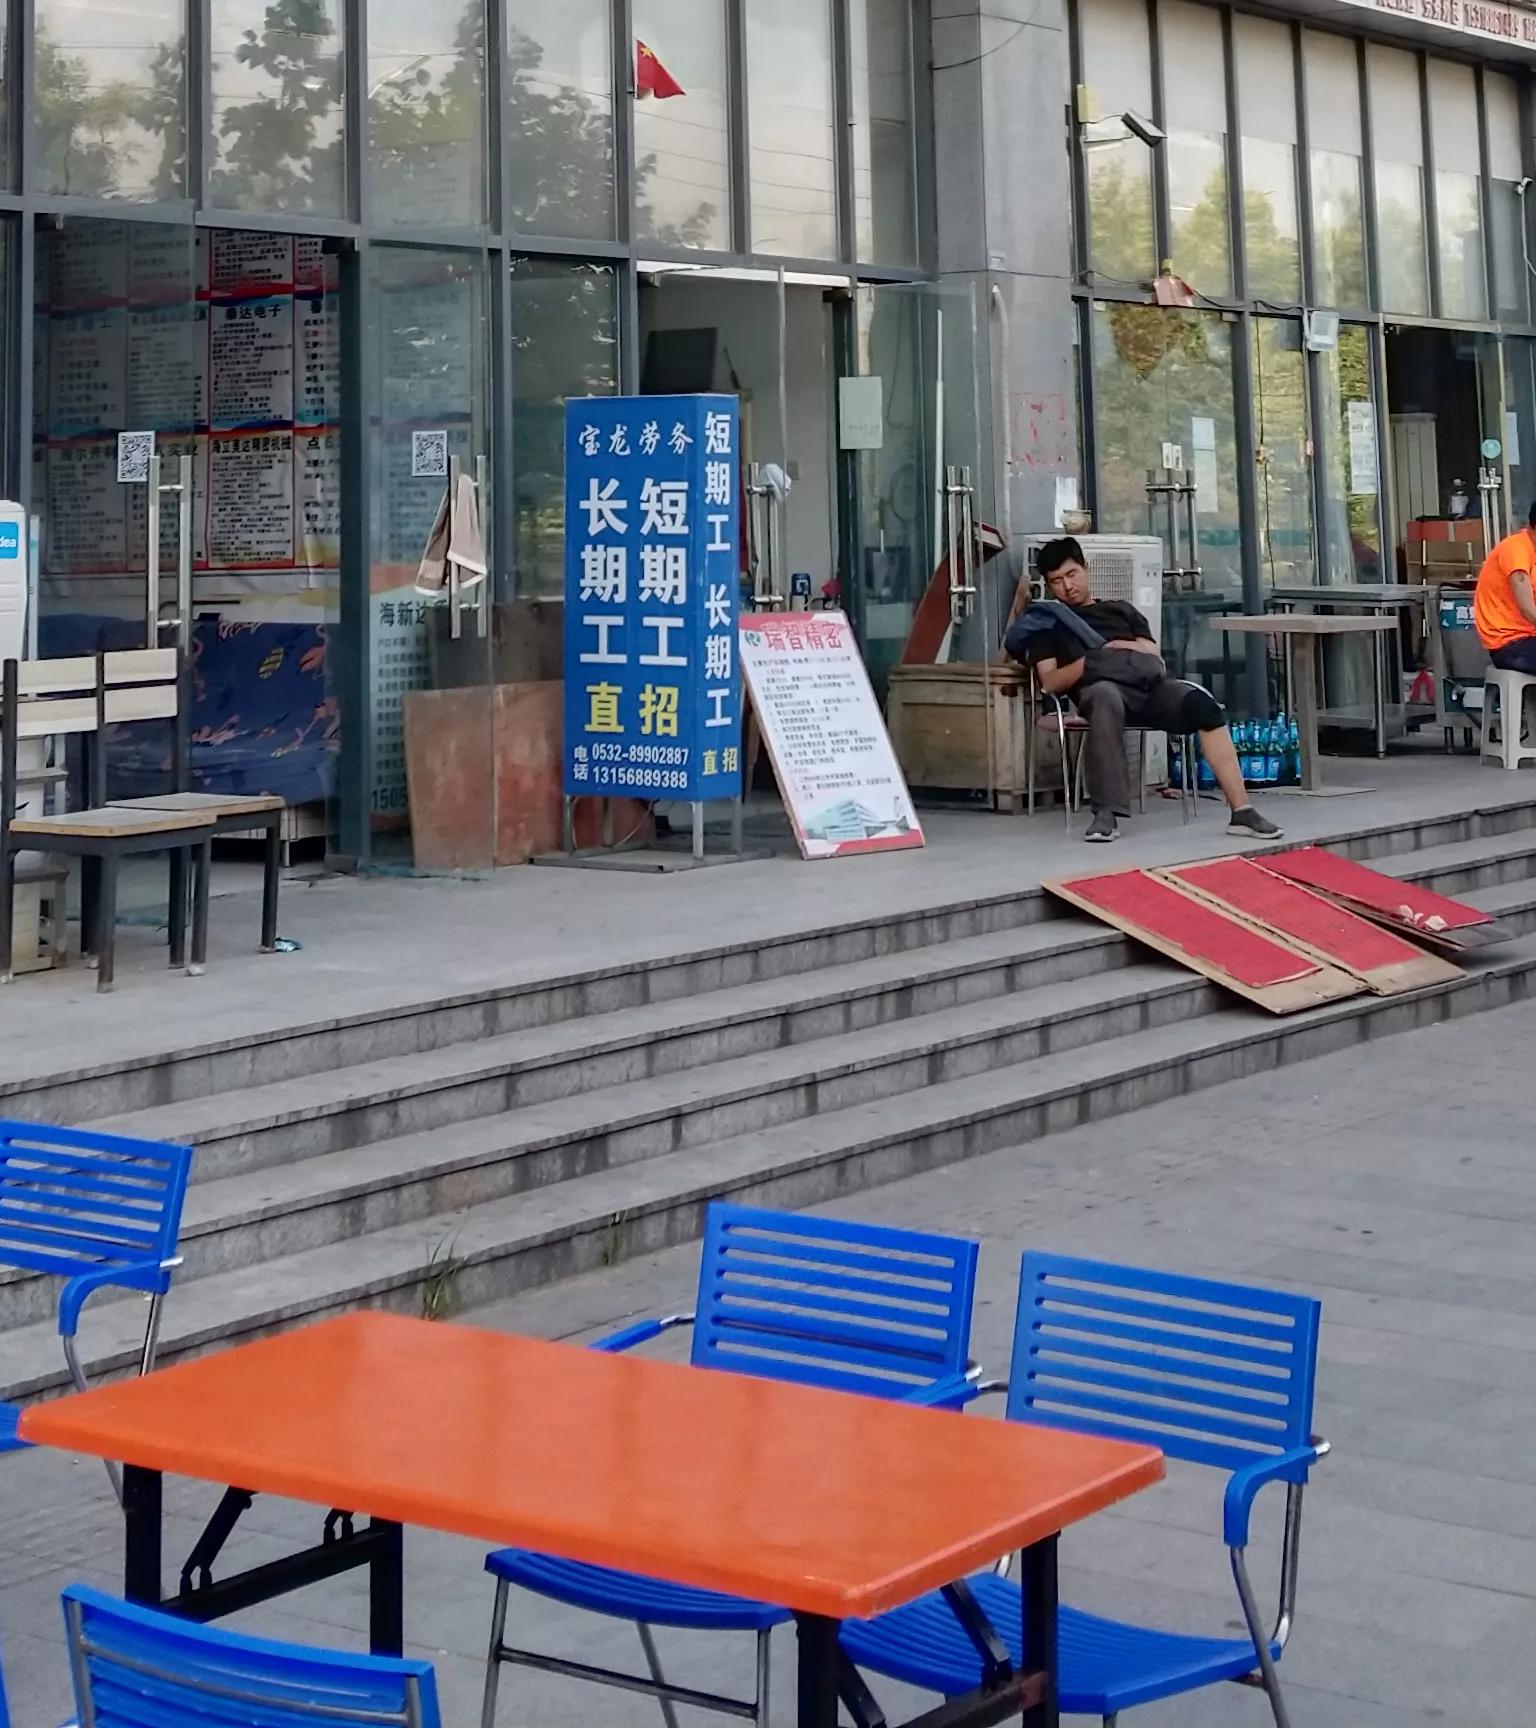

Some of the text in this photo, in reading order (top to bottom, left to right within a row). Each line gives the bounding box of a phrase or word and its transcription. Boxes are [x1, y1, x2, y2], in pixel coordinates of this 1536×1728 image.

[578, 420, 694, 457] 宝龙劳务
[703, 411, 732, 554] 短期工
[578, 476, 629, 666] 长期工
[638, 476, 690, 667] 短期工
[765, 622, 843, 651] 瑞智精密
[703, 584, 732, 728] 长期工
[584, 682, 679, 738] 直招
[573, 745, 589, 781] 电话
[592, 742, 689, 766] 0532-89902887
[702, 747, 739, 776] 直招
[592, 765, 688, 790] 13156889388
